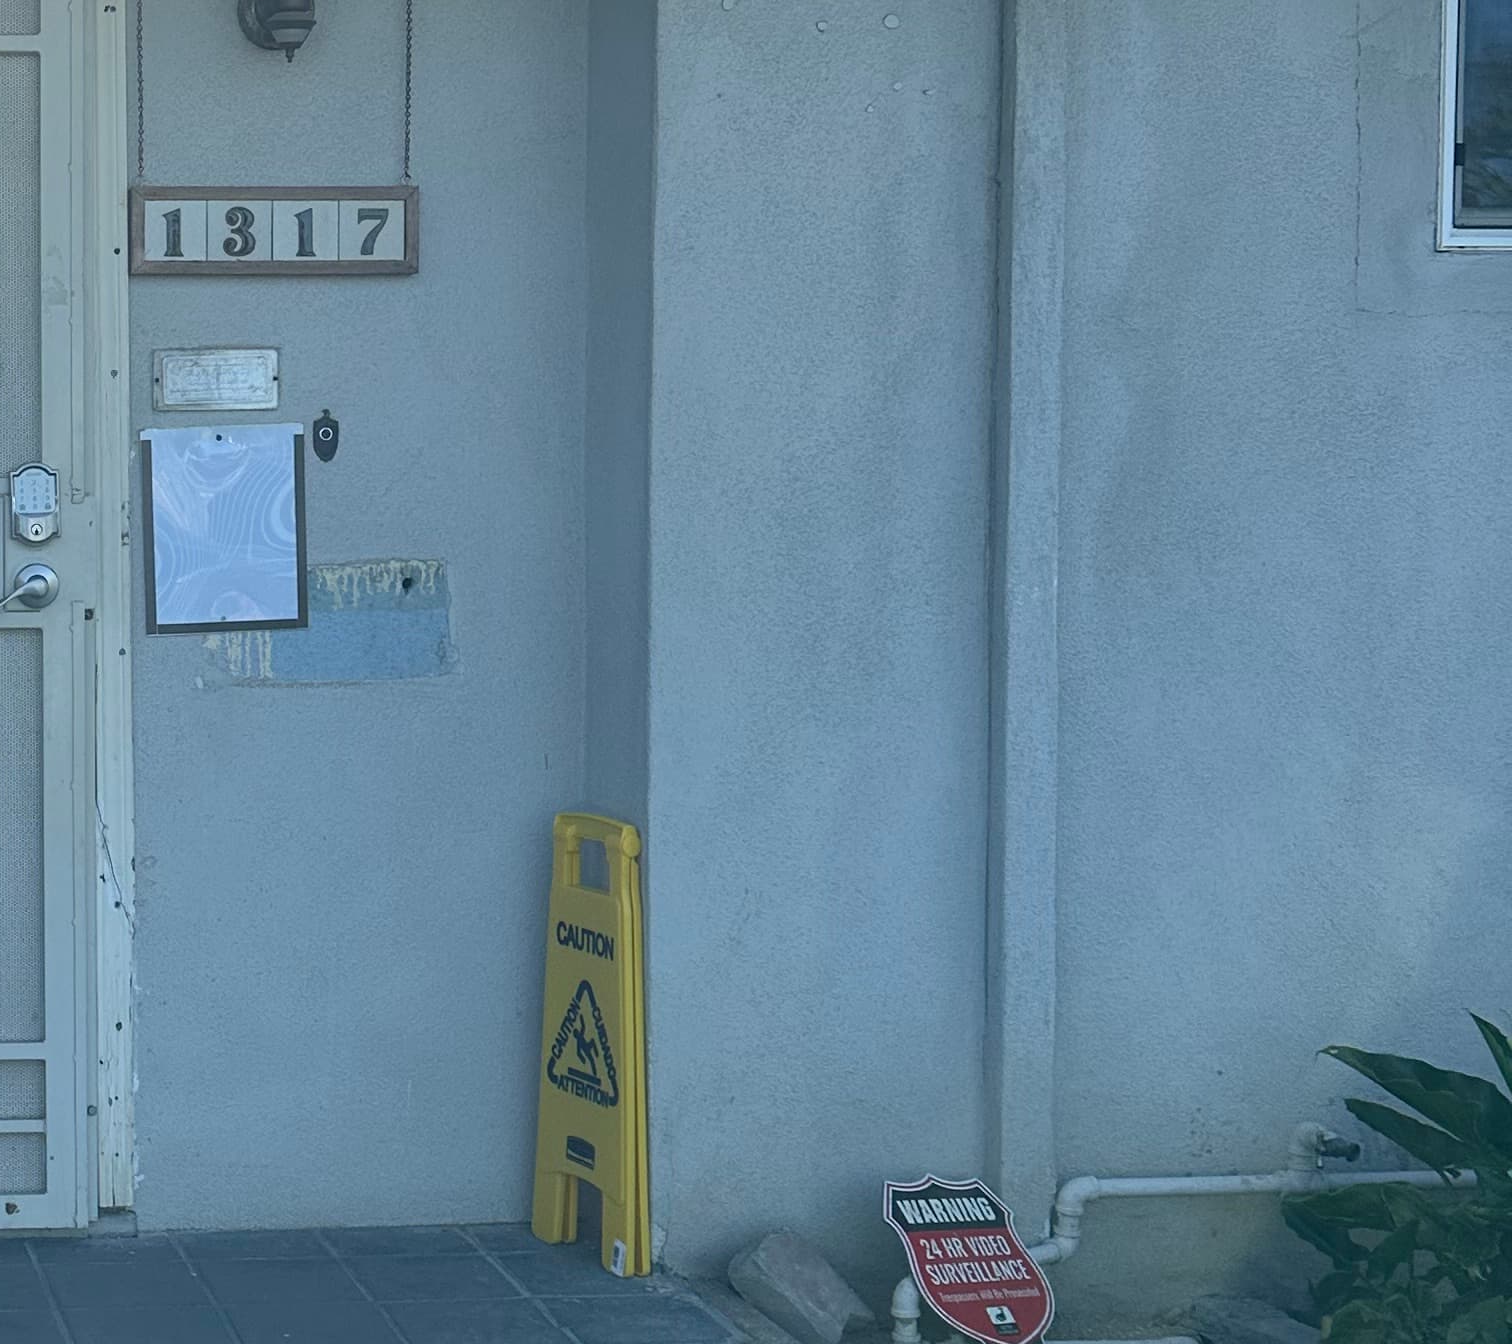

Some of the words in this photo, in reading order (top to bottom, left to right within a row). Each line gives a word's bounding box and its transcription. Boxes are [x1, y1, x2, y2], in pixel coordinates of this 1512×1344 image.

[556, 921, 614, 961] CAUTION
[551, 997, 580, 1060] CAUTION
[591, 1006, 617, 1077] CUIDADO
[557, 1077, 610, 1108] ATTENTION
[896, 1197, 996, 1225] WARNING
[920, 1239, 942, 1260] 24
[942, 1236, 968, 1258] HR
[965, 1235, 1011, 1257] VIDEO
[925, 1259, 1031, 1286] SURVEILLANCE
